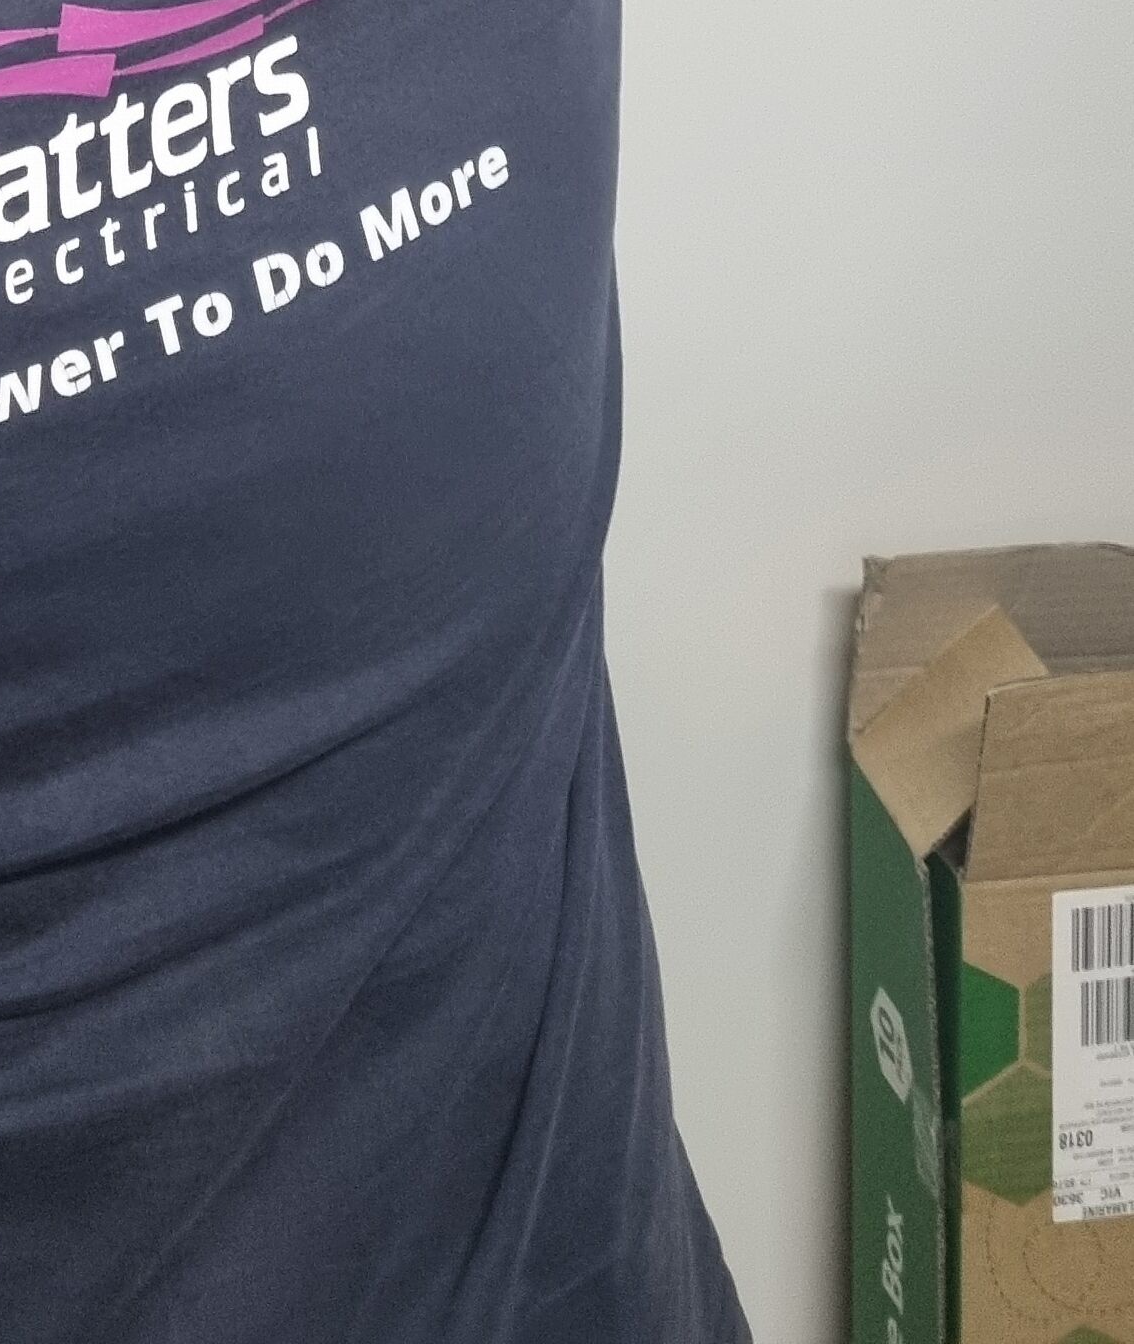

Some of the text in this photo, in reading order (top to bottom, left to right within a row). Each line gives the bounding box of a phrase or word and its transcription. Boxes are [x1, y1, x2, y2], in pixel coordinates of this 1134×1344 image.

[144, 291, 233, 356] To
[252, 241, 345, 313] Do
[359, 145, 510, 261] More
